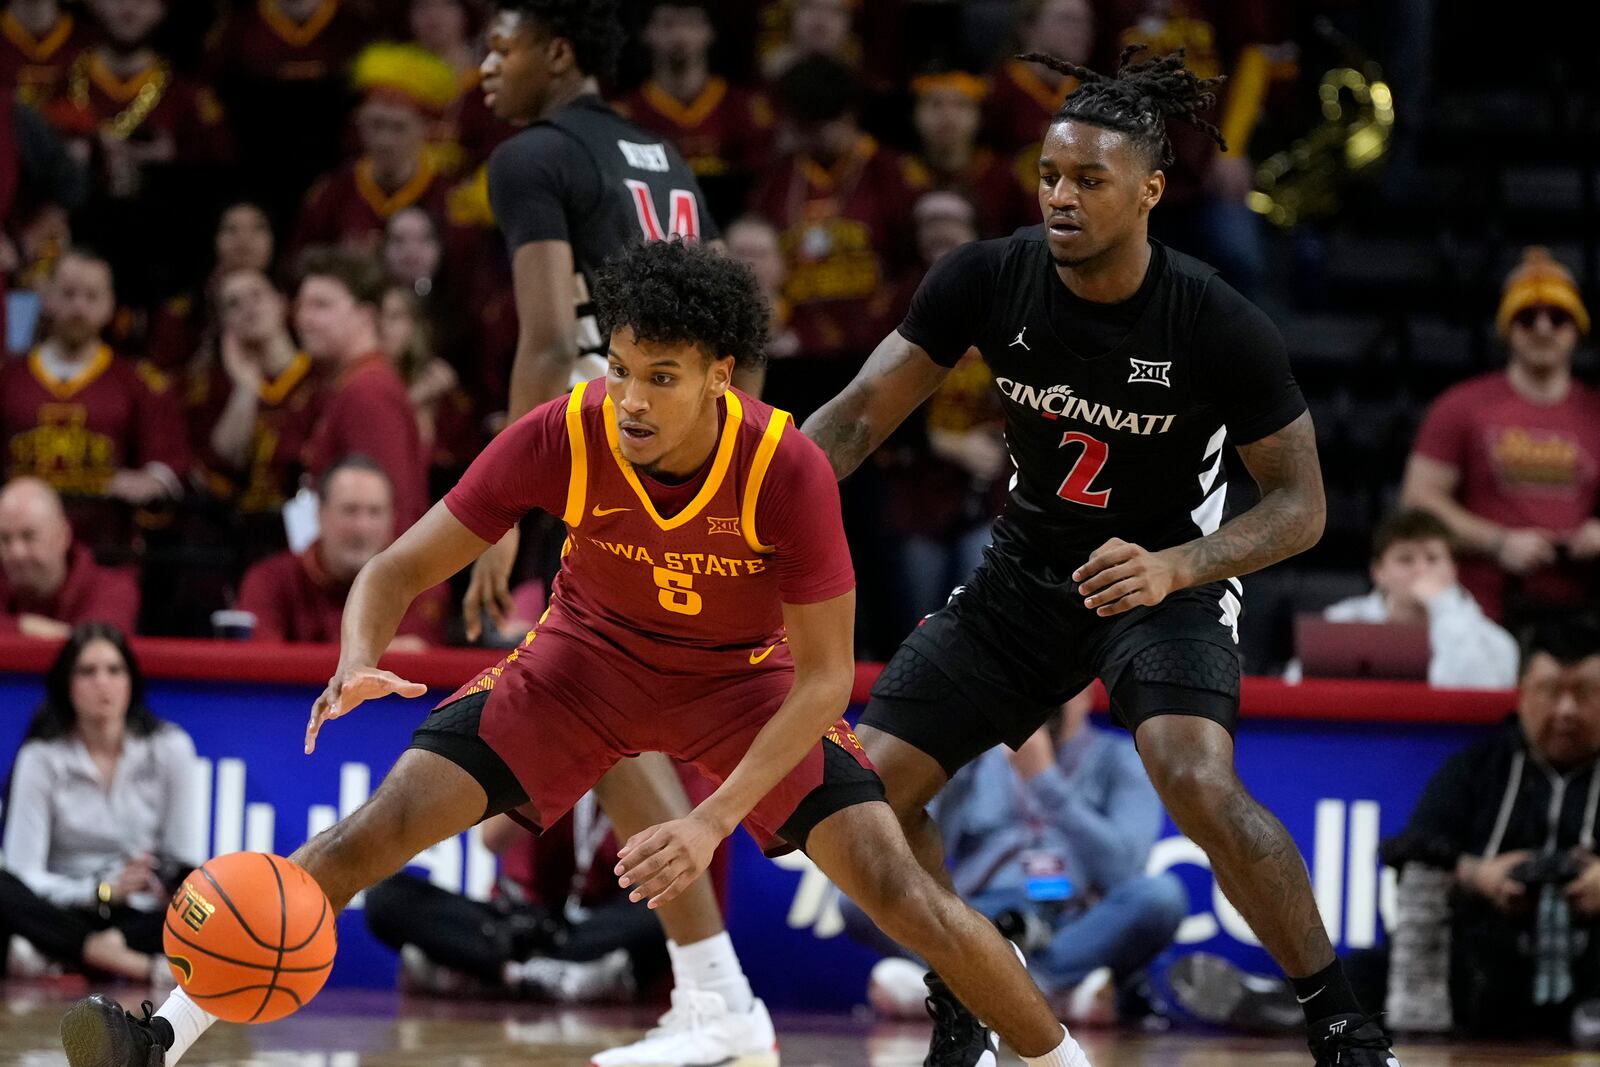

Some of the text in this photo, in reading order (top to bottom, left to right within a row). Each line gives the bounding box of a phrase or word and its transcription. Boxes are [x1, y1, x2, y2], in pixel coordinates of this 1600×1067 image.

[996, 377, 1177, 435] CINCINNATI
[1056, 431, 1112, 508] 2
[664, 552, 766, 576] STATE
